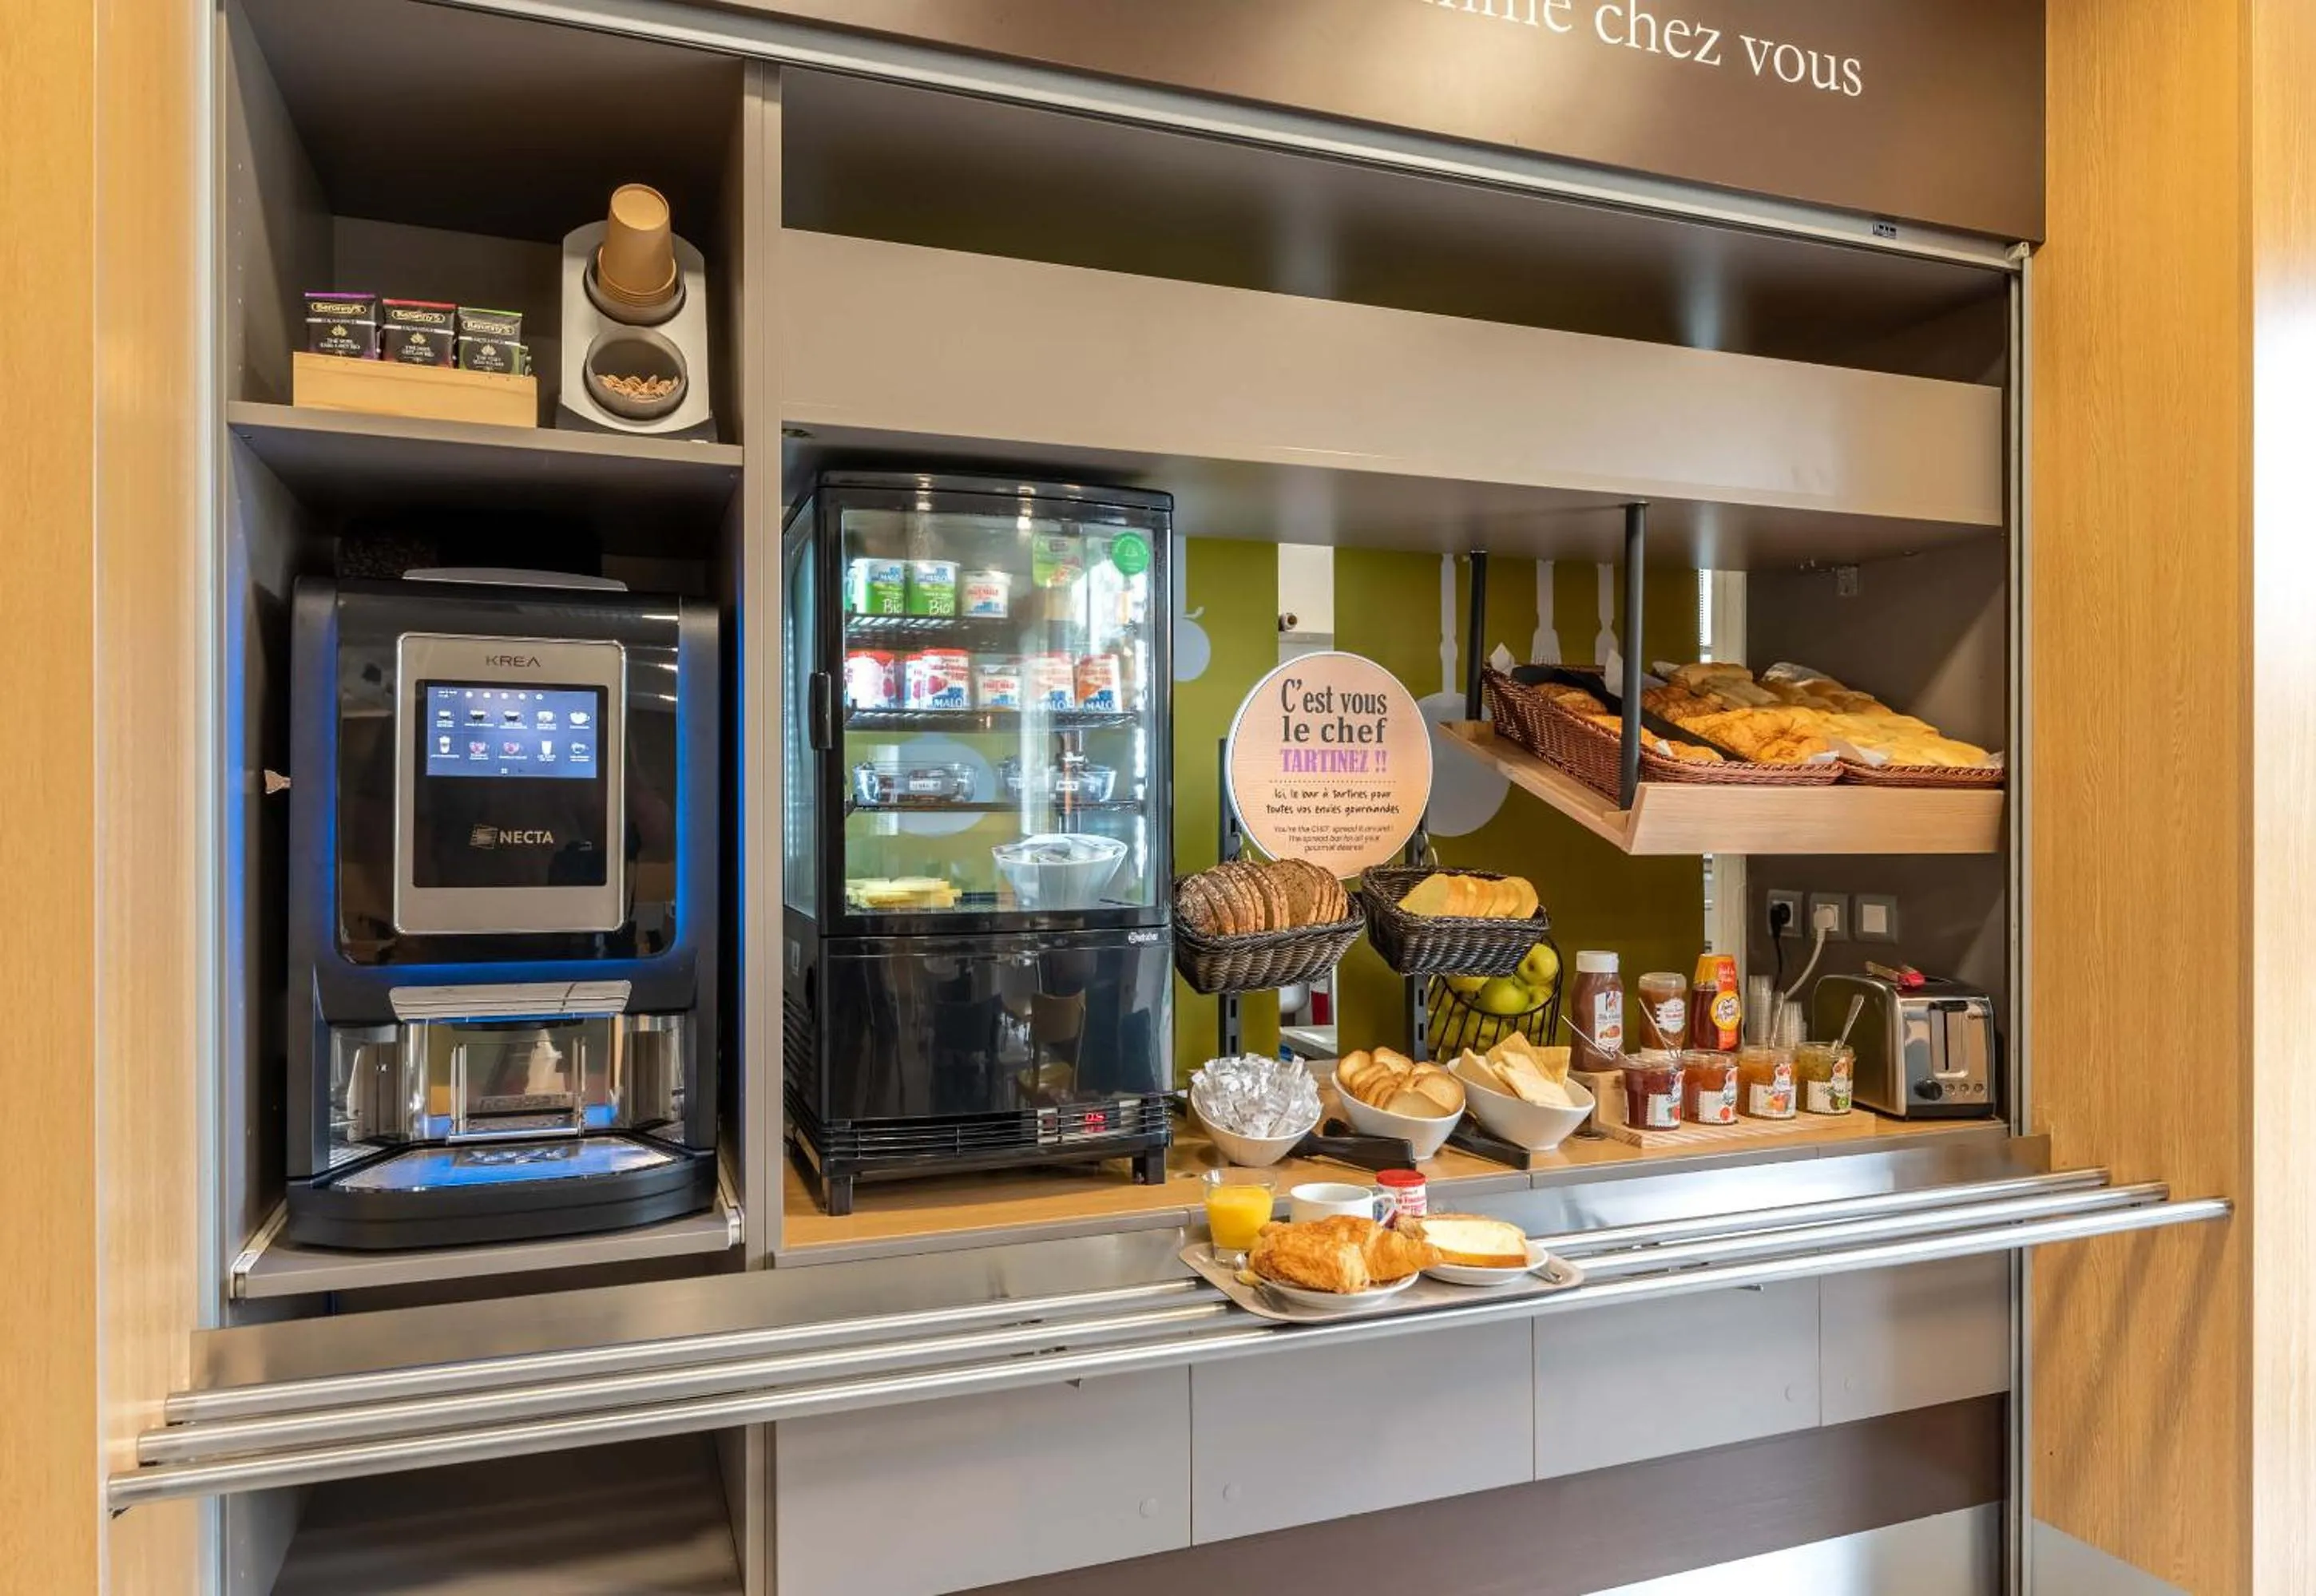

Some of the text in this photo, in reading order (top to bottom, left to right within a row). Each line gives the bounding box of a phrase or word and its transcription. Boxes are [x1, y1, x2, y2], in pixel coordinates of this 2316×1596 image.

[1595, 0, 1721, 66] chez
[1739, 34, 1862, 97] vous
[485, 655, 541, 667] KREA
[1281, 679, 1387, 715] C'est vous
[1282, 715, 1387, 743] le chef
[1280, 749, 1369, 773] TARTINEZ
[1333, 789, 1367, 799] tartines
[1371, 790, 1391, 801] pour
[1266, 804, 1293, 814] toutes
[1315, 804, 1341, 814] envies
[1345, 803, 1399, 817] gourmandes
[499, 830, 554, 845] NECTA
